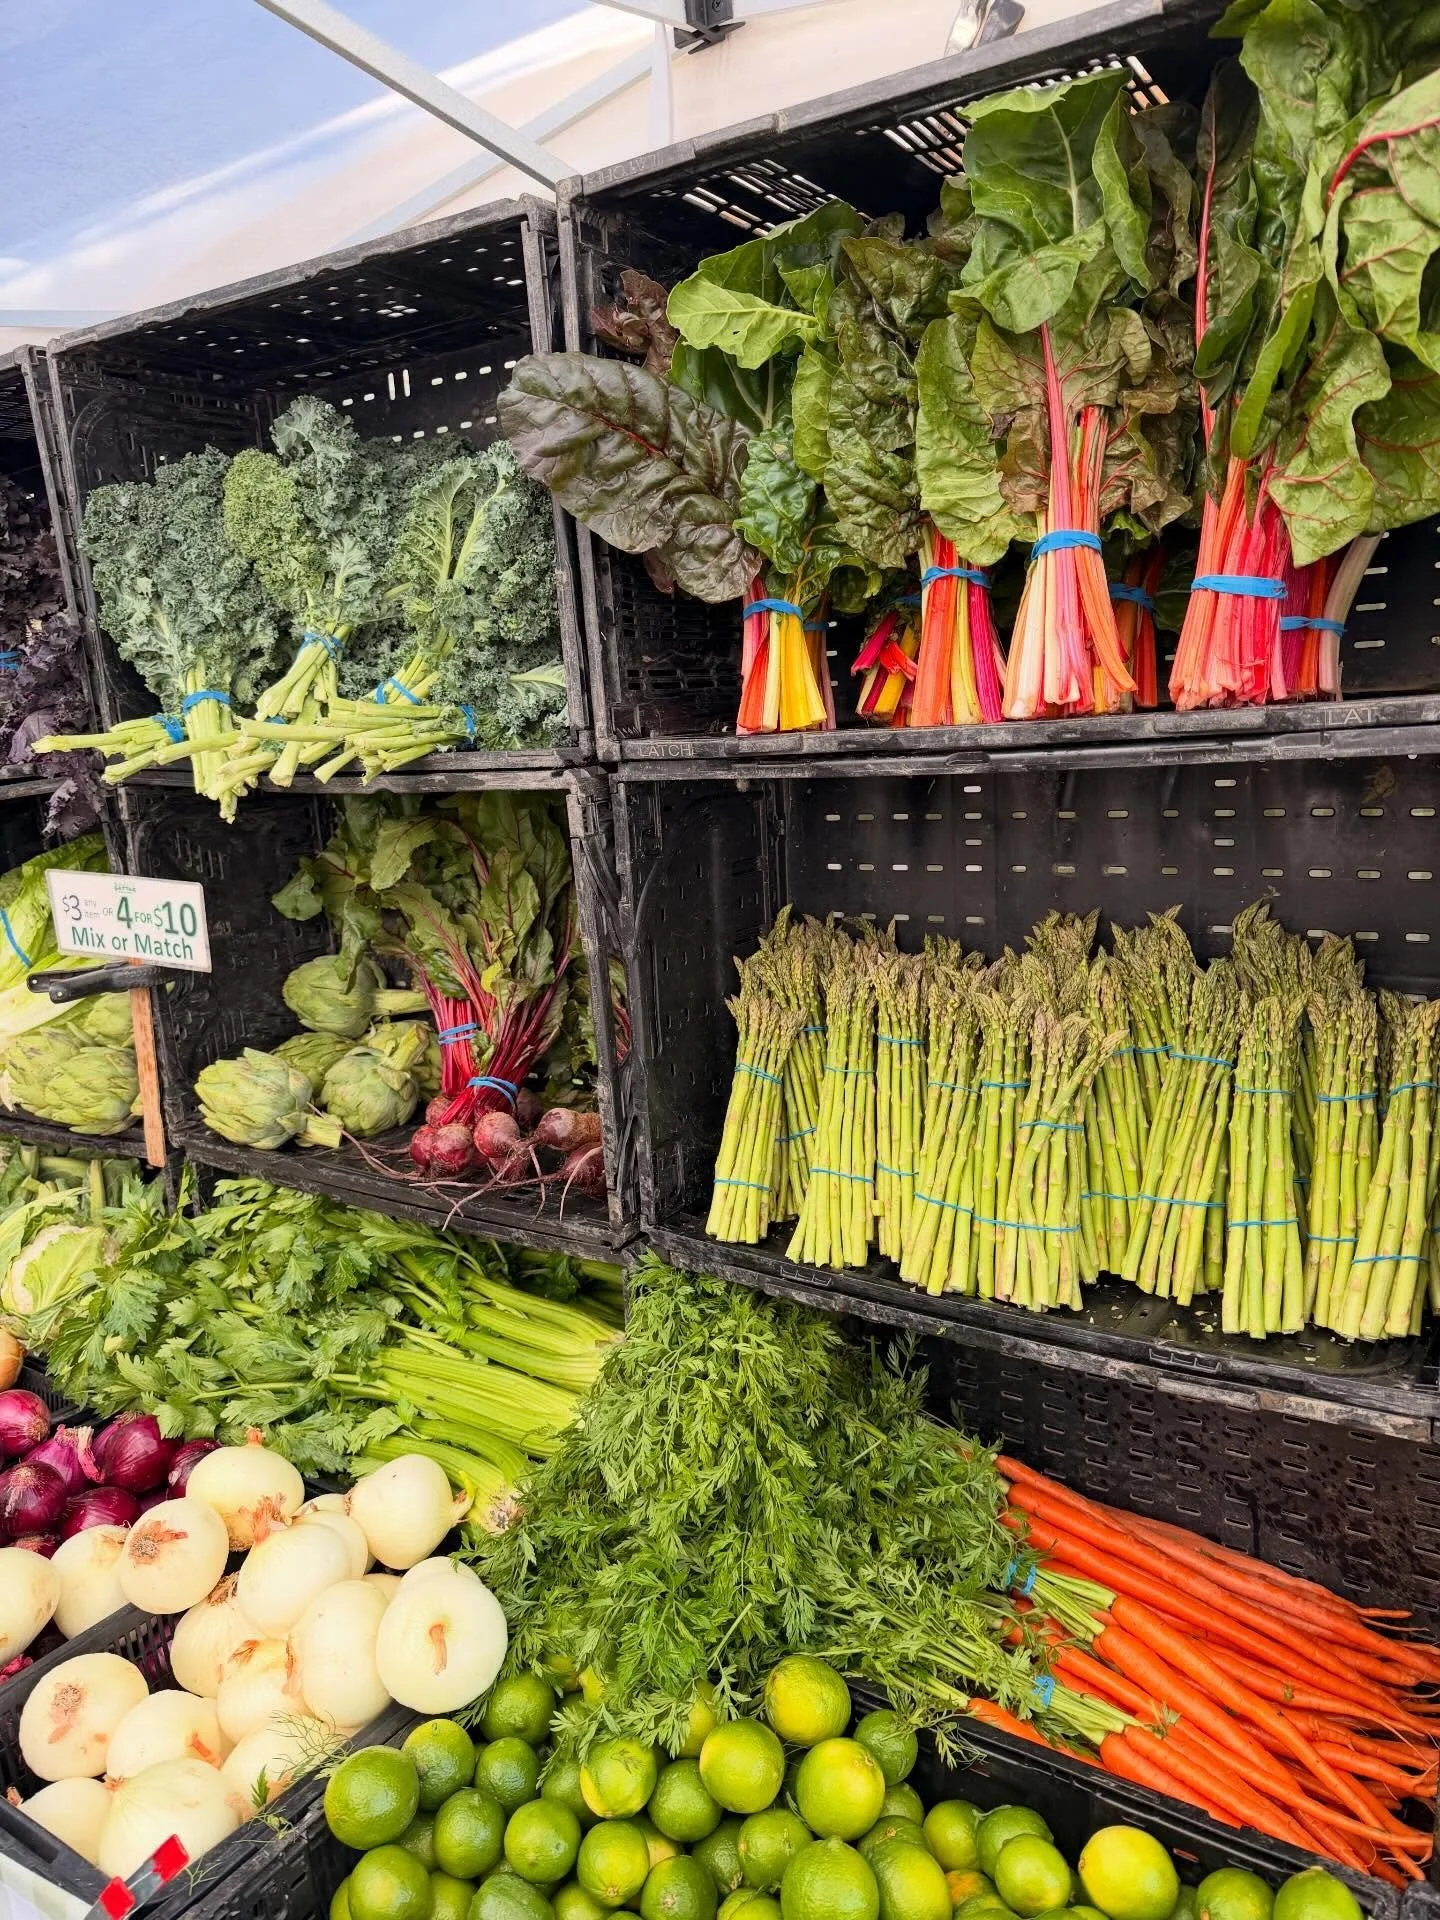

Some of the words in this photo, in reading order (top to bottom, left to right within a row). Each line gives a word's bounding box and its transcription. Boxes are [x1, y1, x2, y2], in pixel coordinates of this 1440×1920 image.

[639, 744, 691, 757] LATCH
[62, 894, 82, 921] $3
[102, 907, 114, 917] OR
[117, 896, 133, 929] 4
[135, 911, 153, 924] FOR
[154, 901, 197, 937] $10
[72, 926, 106, 949] Mix
[112, 935, 128, 951] or
[135, 933, 194, 960] Match
